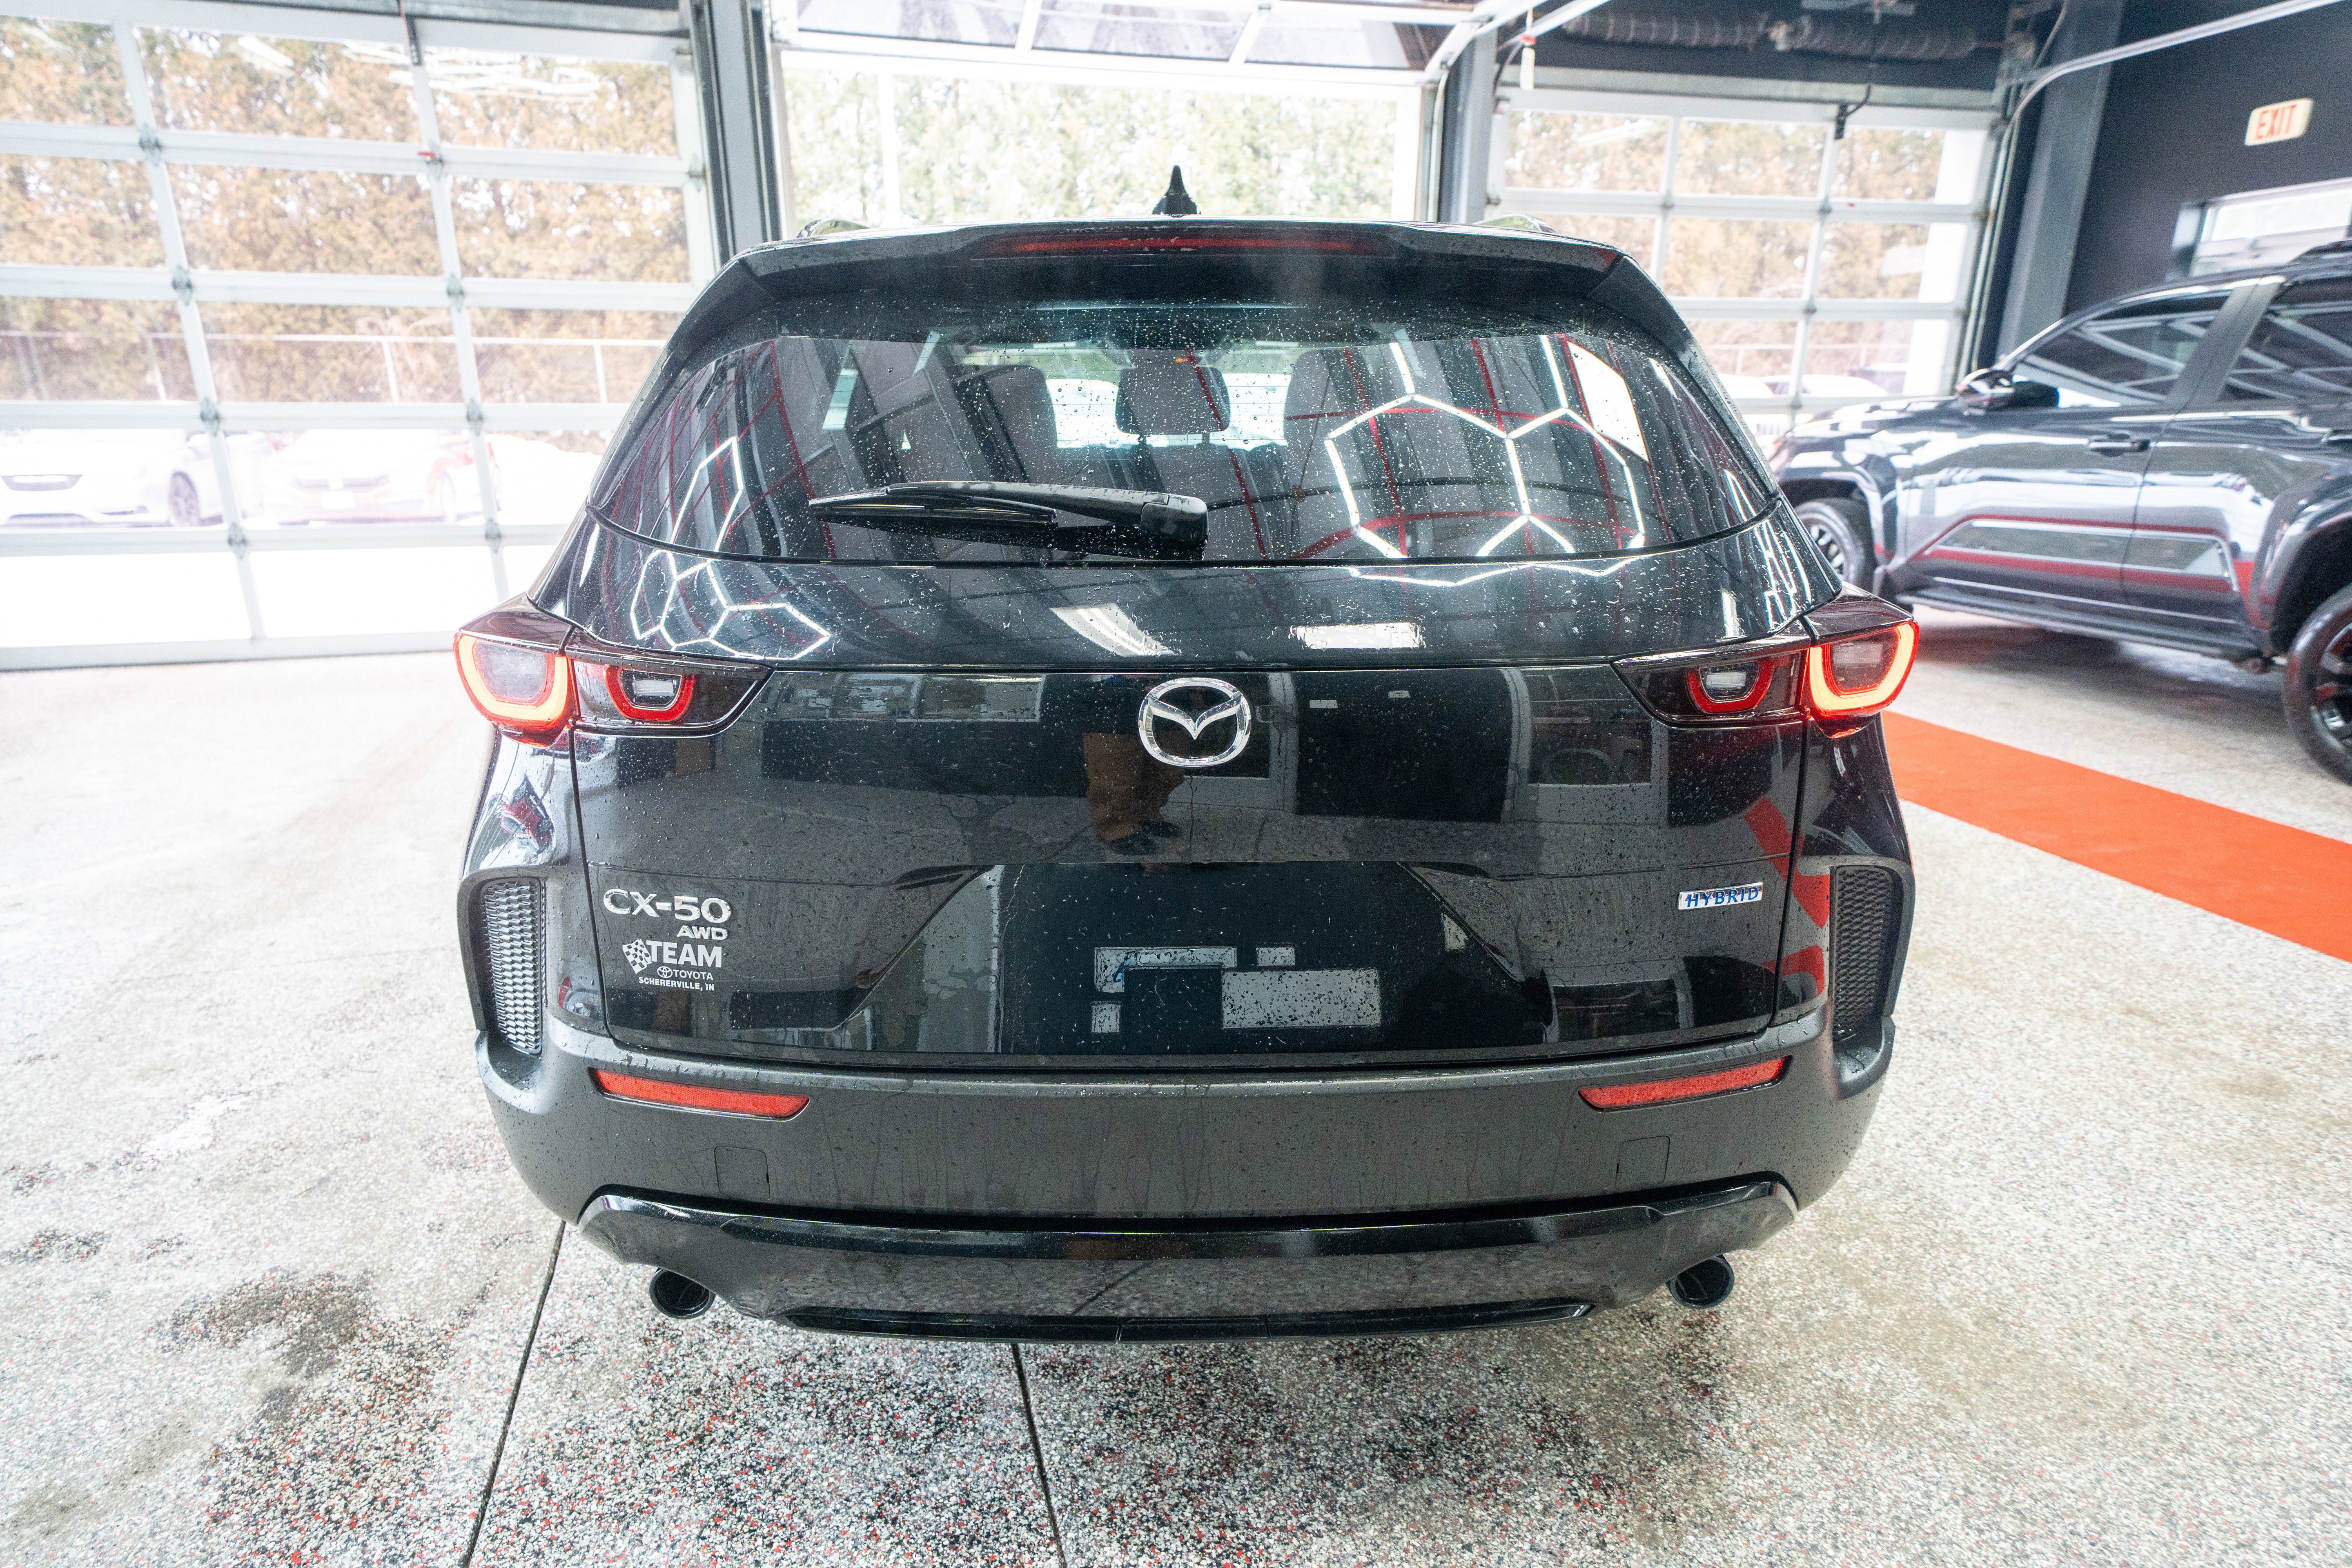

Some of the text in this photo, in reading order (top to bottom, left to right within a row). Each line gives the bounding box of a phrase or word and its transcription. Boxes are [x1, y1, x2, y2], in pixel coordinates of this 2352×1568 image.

[2255, 104, 2297, 140] EXIT
[603, 889, 731, 924] CX-50
[1687, 886, 1759, 908] HYBRID
[676, 925, 729, 940] AWD
[646, 940, 722, 968] TEAM
[638, 976, 715, 991] SCHERERVILLE, IN
[673, 969, 714, 980] TOYOTA
